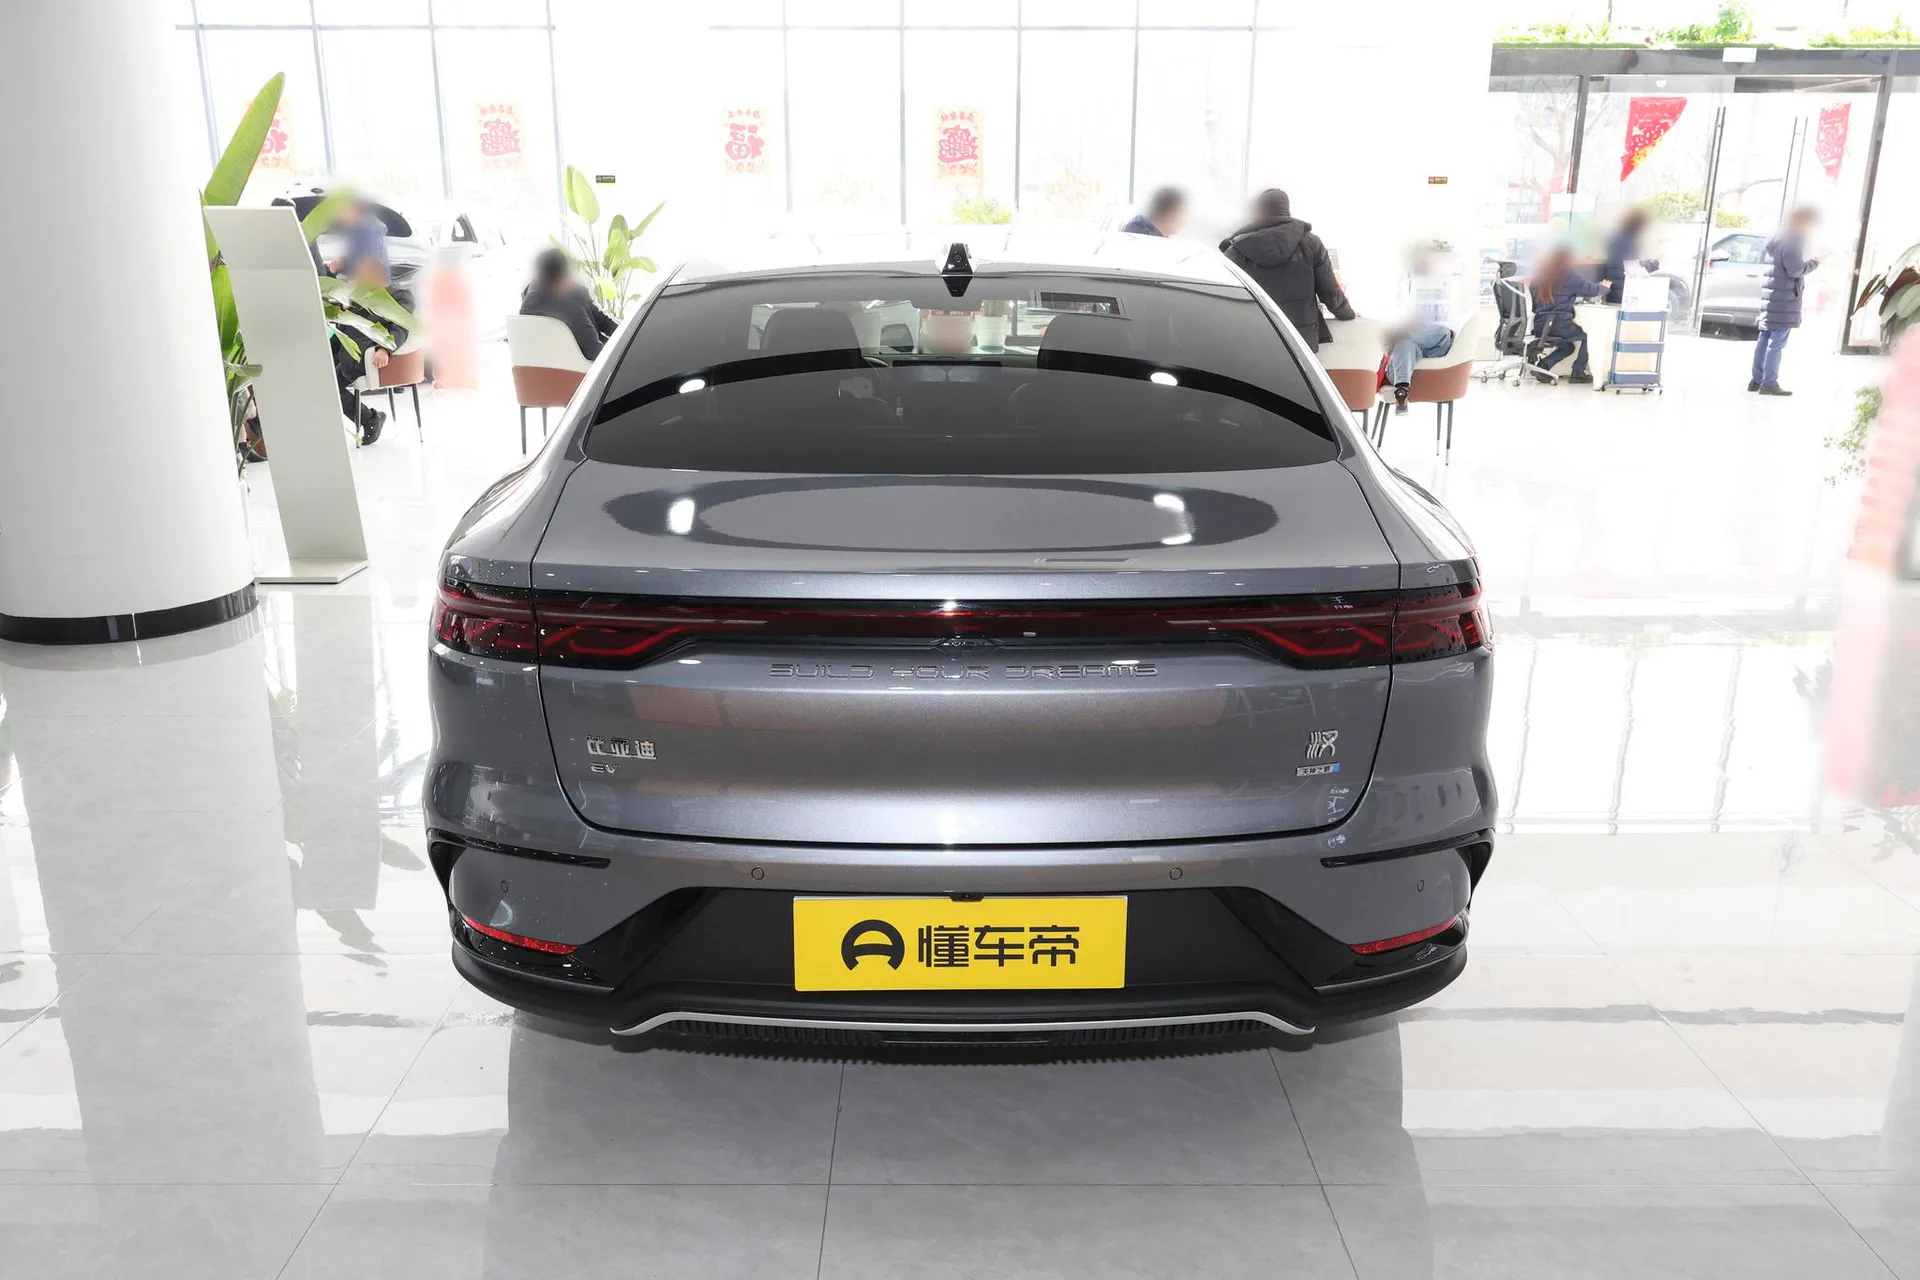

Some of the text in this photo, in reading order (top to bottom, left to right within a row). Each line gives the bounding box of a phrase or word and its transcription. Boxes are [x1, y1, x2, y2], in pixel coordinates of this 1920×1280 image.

[770, 663, 1158, 680] BUILD YOUR DREAMS
[586, 735, 658, 760] 比亚迪
[590, 762, 618, 775] EV
[917, 924, 1080, 968] 懂车帝
